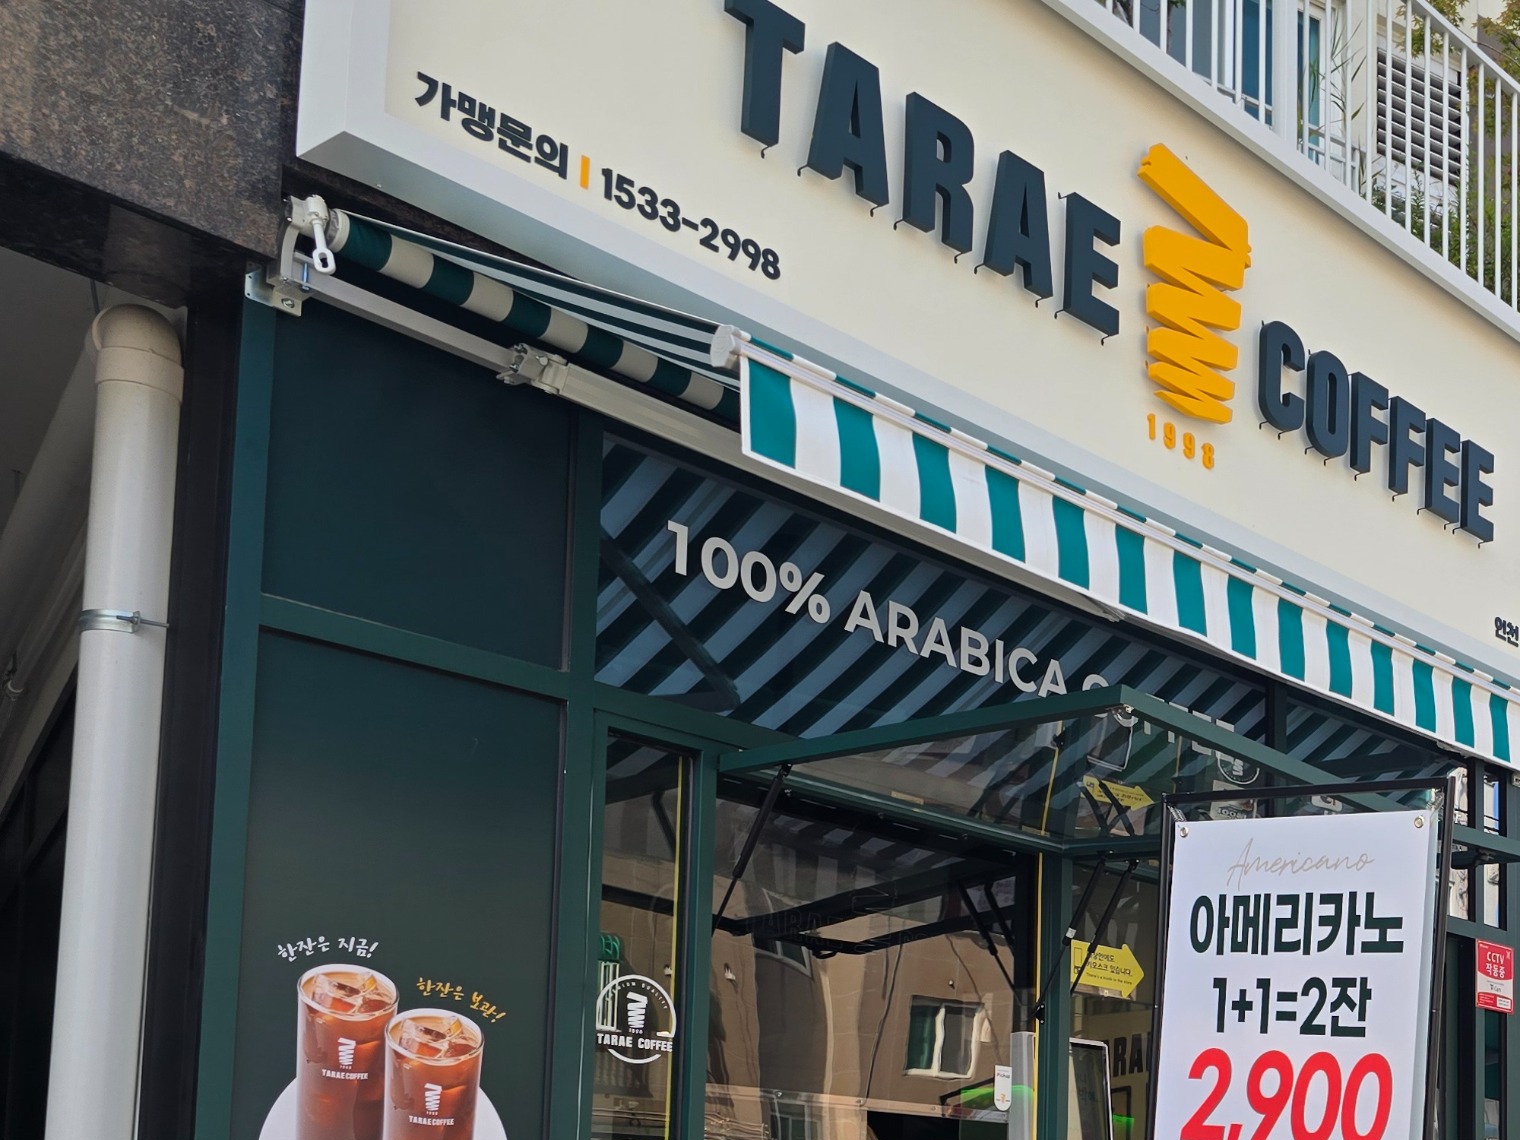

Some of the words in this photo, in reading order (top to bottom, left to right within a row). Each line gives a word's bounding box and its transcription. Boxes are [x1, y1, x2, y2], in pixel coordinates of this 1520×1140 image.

[416, 71, 568, 180] 가맹문의
[601, 166, 782, 281] 1533-2998
[724, 0, 1121, 337] TARAE
[1147, 413, 1215, 470] 1998
[1259, 320, 1494, 543] COFFEE
[667, 520, 831, 624] 100%
[844, 590, 1068, 698] ARABICA
[1495, 616, 1519, 648] 인천
[1226, 838, 1375, 890] Americano
[278, 936, 330, 962] 한잔은
[338, 936, 379, 959] 지금!
[1190, 891, 1404, 956] 아메리카노
[1485, 963, 1506, 979] 작동중
[1486, 951, 1505, 965] CCTV
[416, 977, 464, 1000] 한잔은
[470, 992, 507, 1022] 보관!
[1213, 976, 1372, 1037] 1+1=2잔
[597, 1033, 633, 1048] TARAE
[637, 1037, 673, 1053] COFFEE
